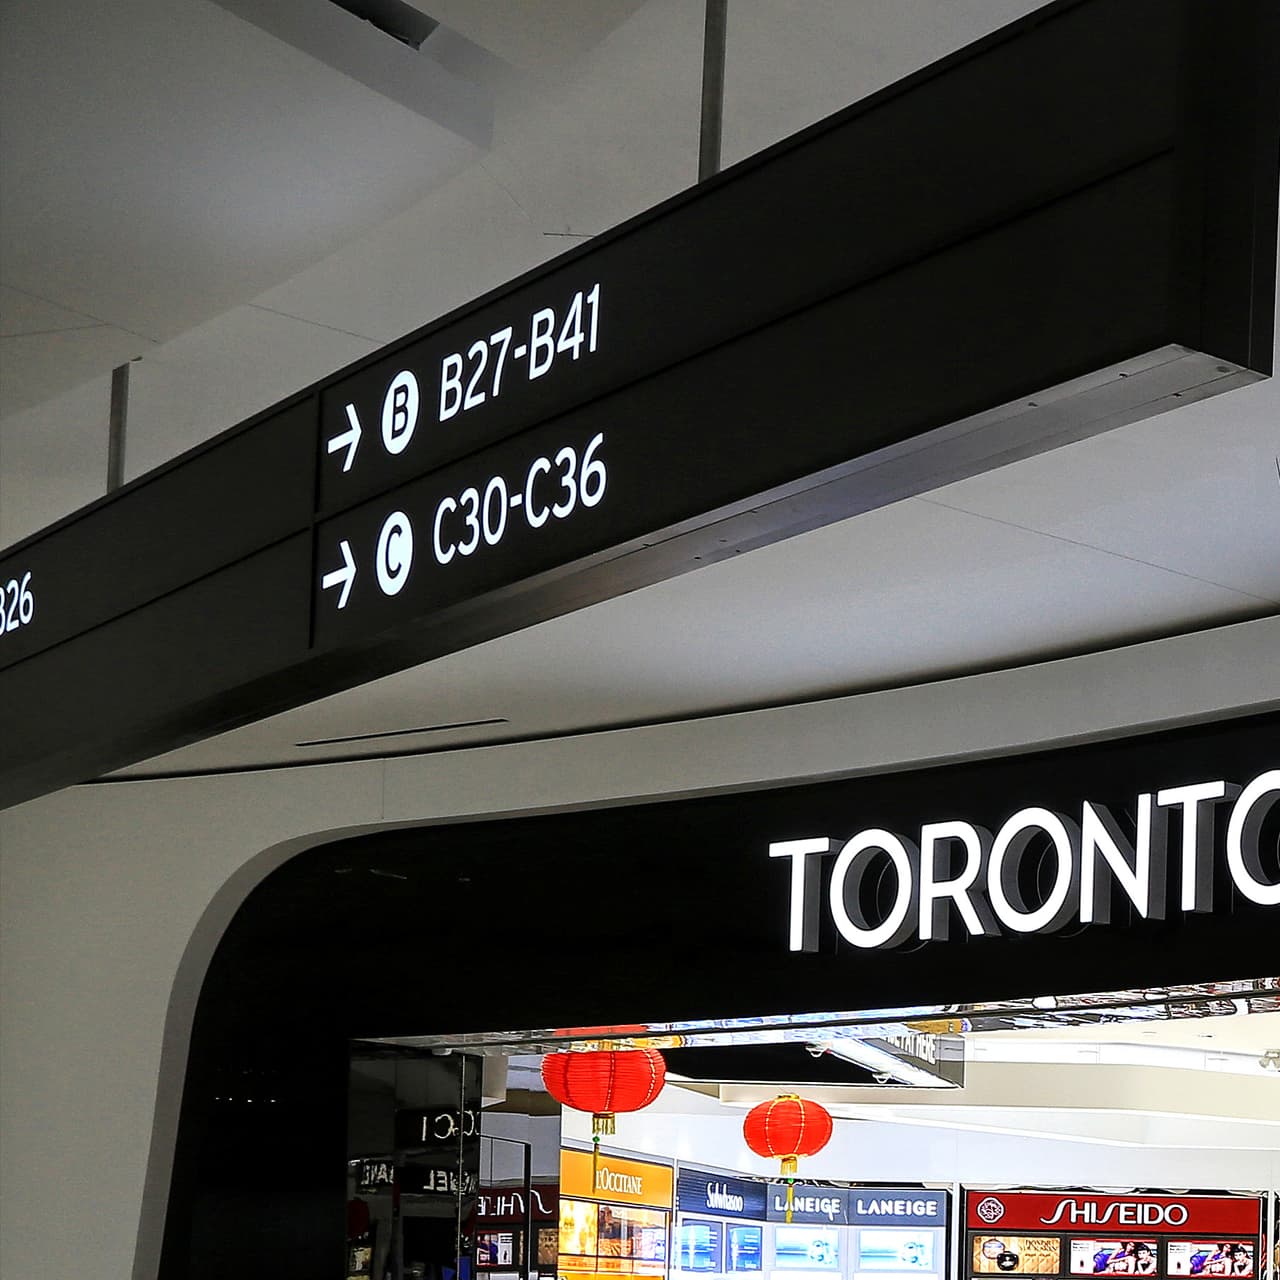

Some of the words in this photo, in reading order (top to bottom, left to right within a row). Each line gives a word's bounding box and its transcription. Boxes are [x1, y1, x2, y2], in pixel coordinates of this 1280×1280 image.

[438, 282, 600, 423] B27-B41
[432, 432, 607, 566] C30-C36
[856, 1199, 938, 1216] LANEIGE
[1039, 1198, 1189, 1226] SHISEIDO
